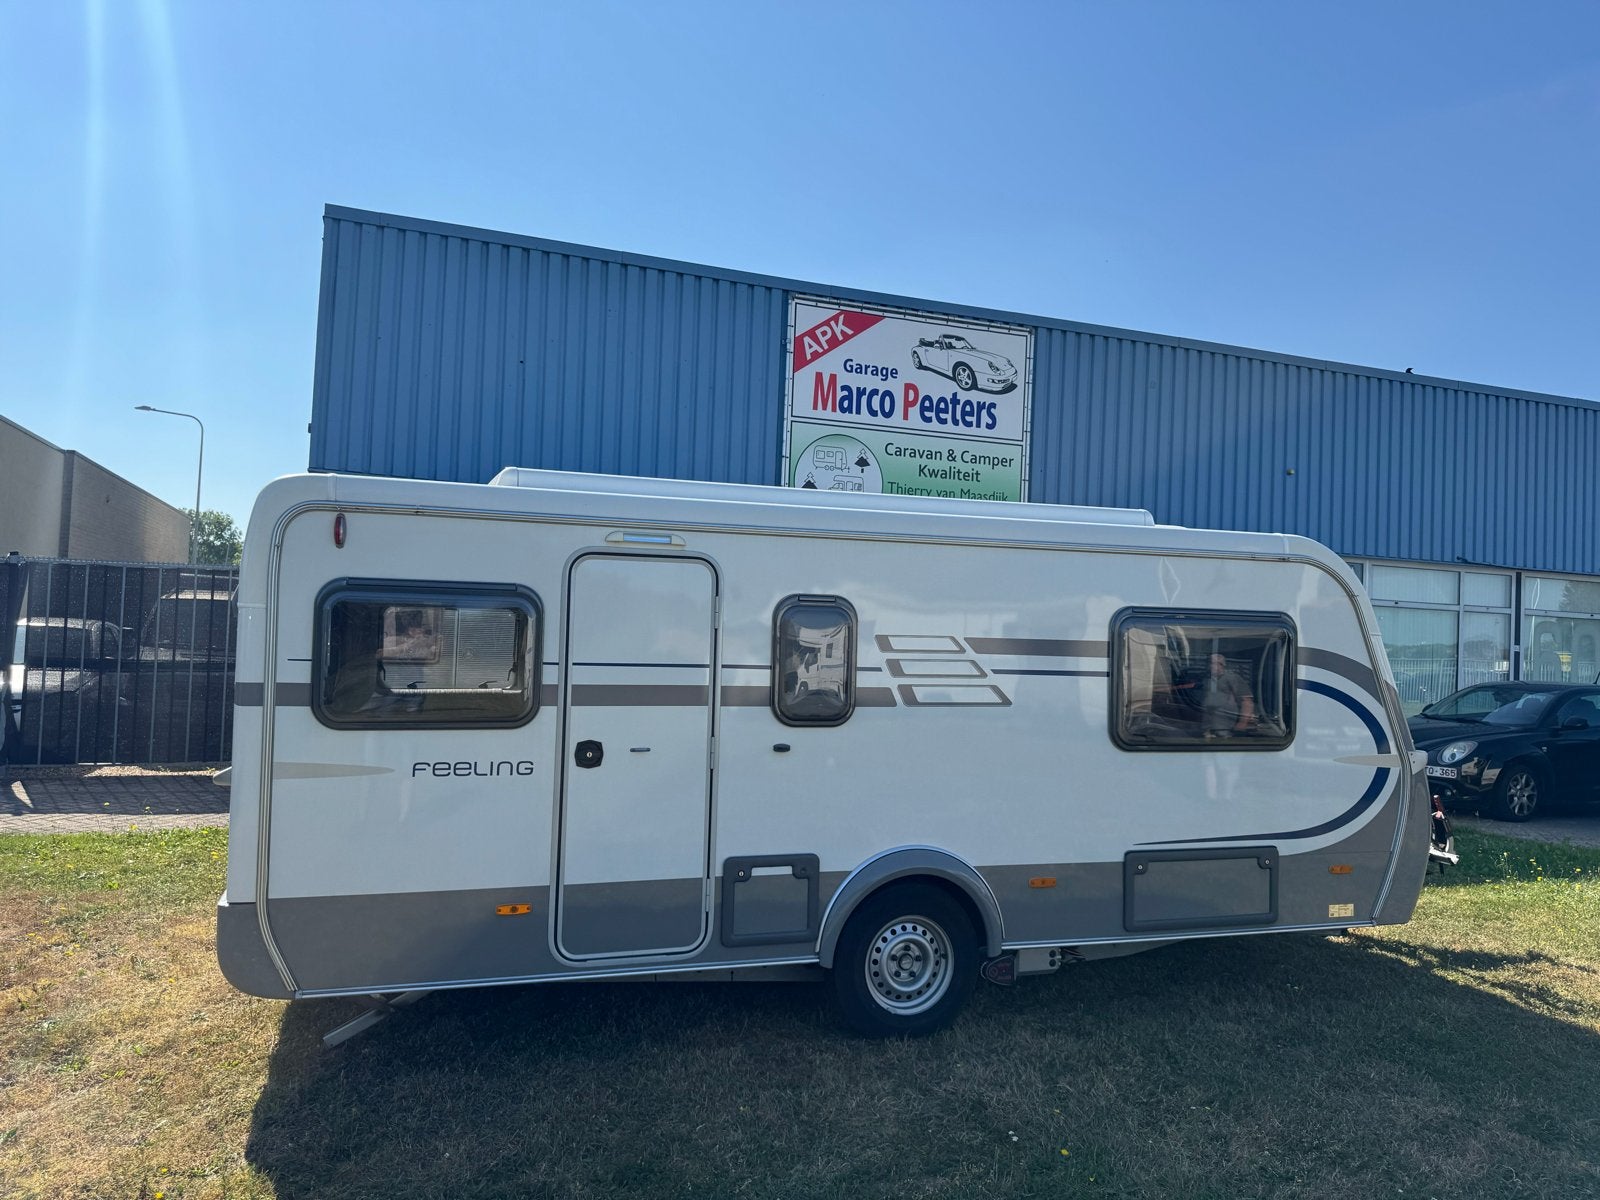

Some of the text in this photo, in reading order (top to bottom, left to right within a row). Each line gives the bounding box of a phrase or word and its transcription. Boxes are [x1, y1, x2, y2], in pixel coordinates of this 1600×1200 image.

[802, 314, 854, 361] APK
[843, 358, 898, 381] Garage
[812, 371, 997, 430] Marco Peeters
[885, 442, 1014, 470] Caravan & Camper
[918, 464, 981, 482] Kwaliteit
[888, 481, 932, 496] Thierry
[936, 489, 955, 498] van
